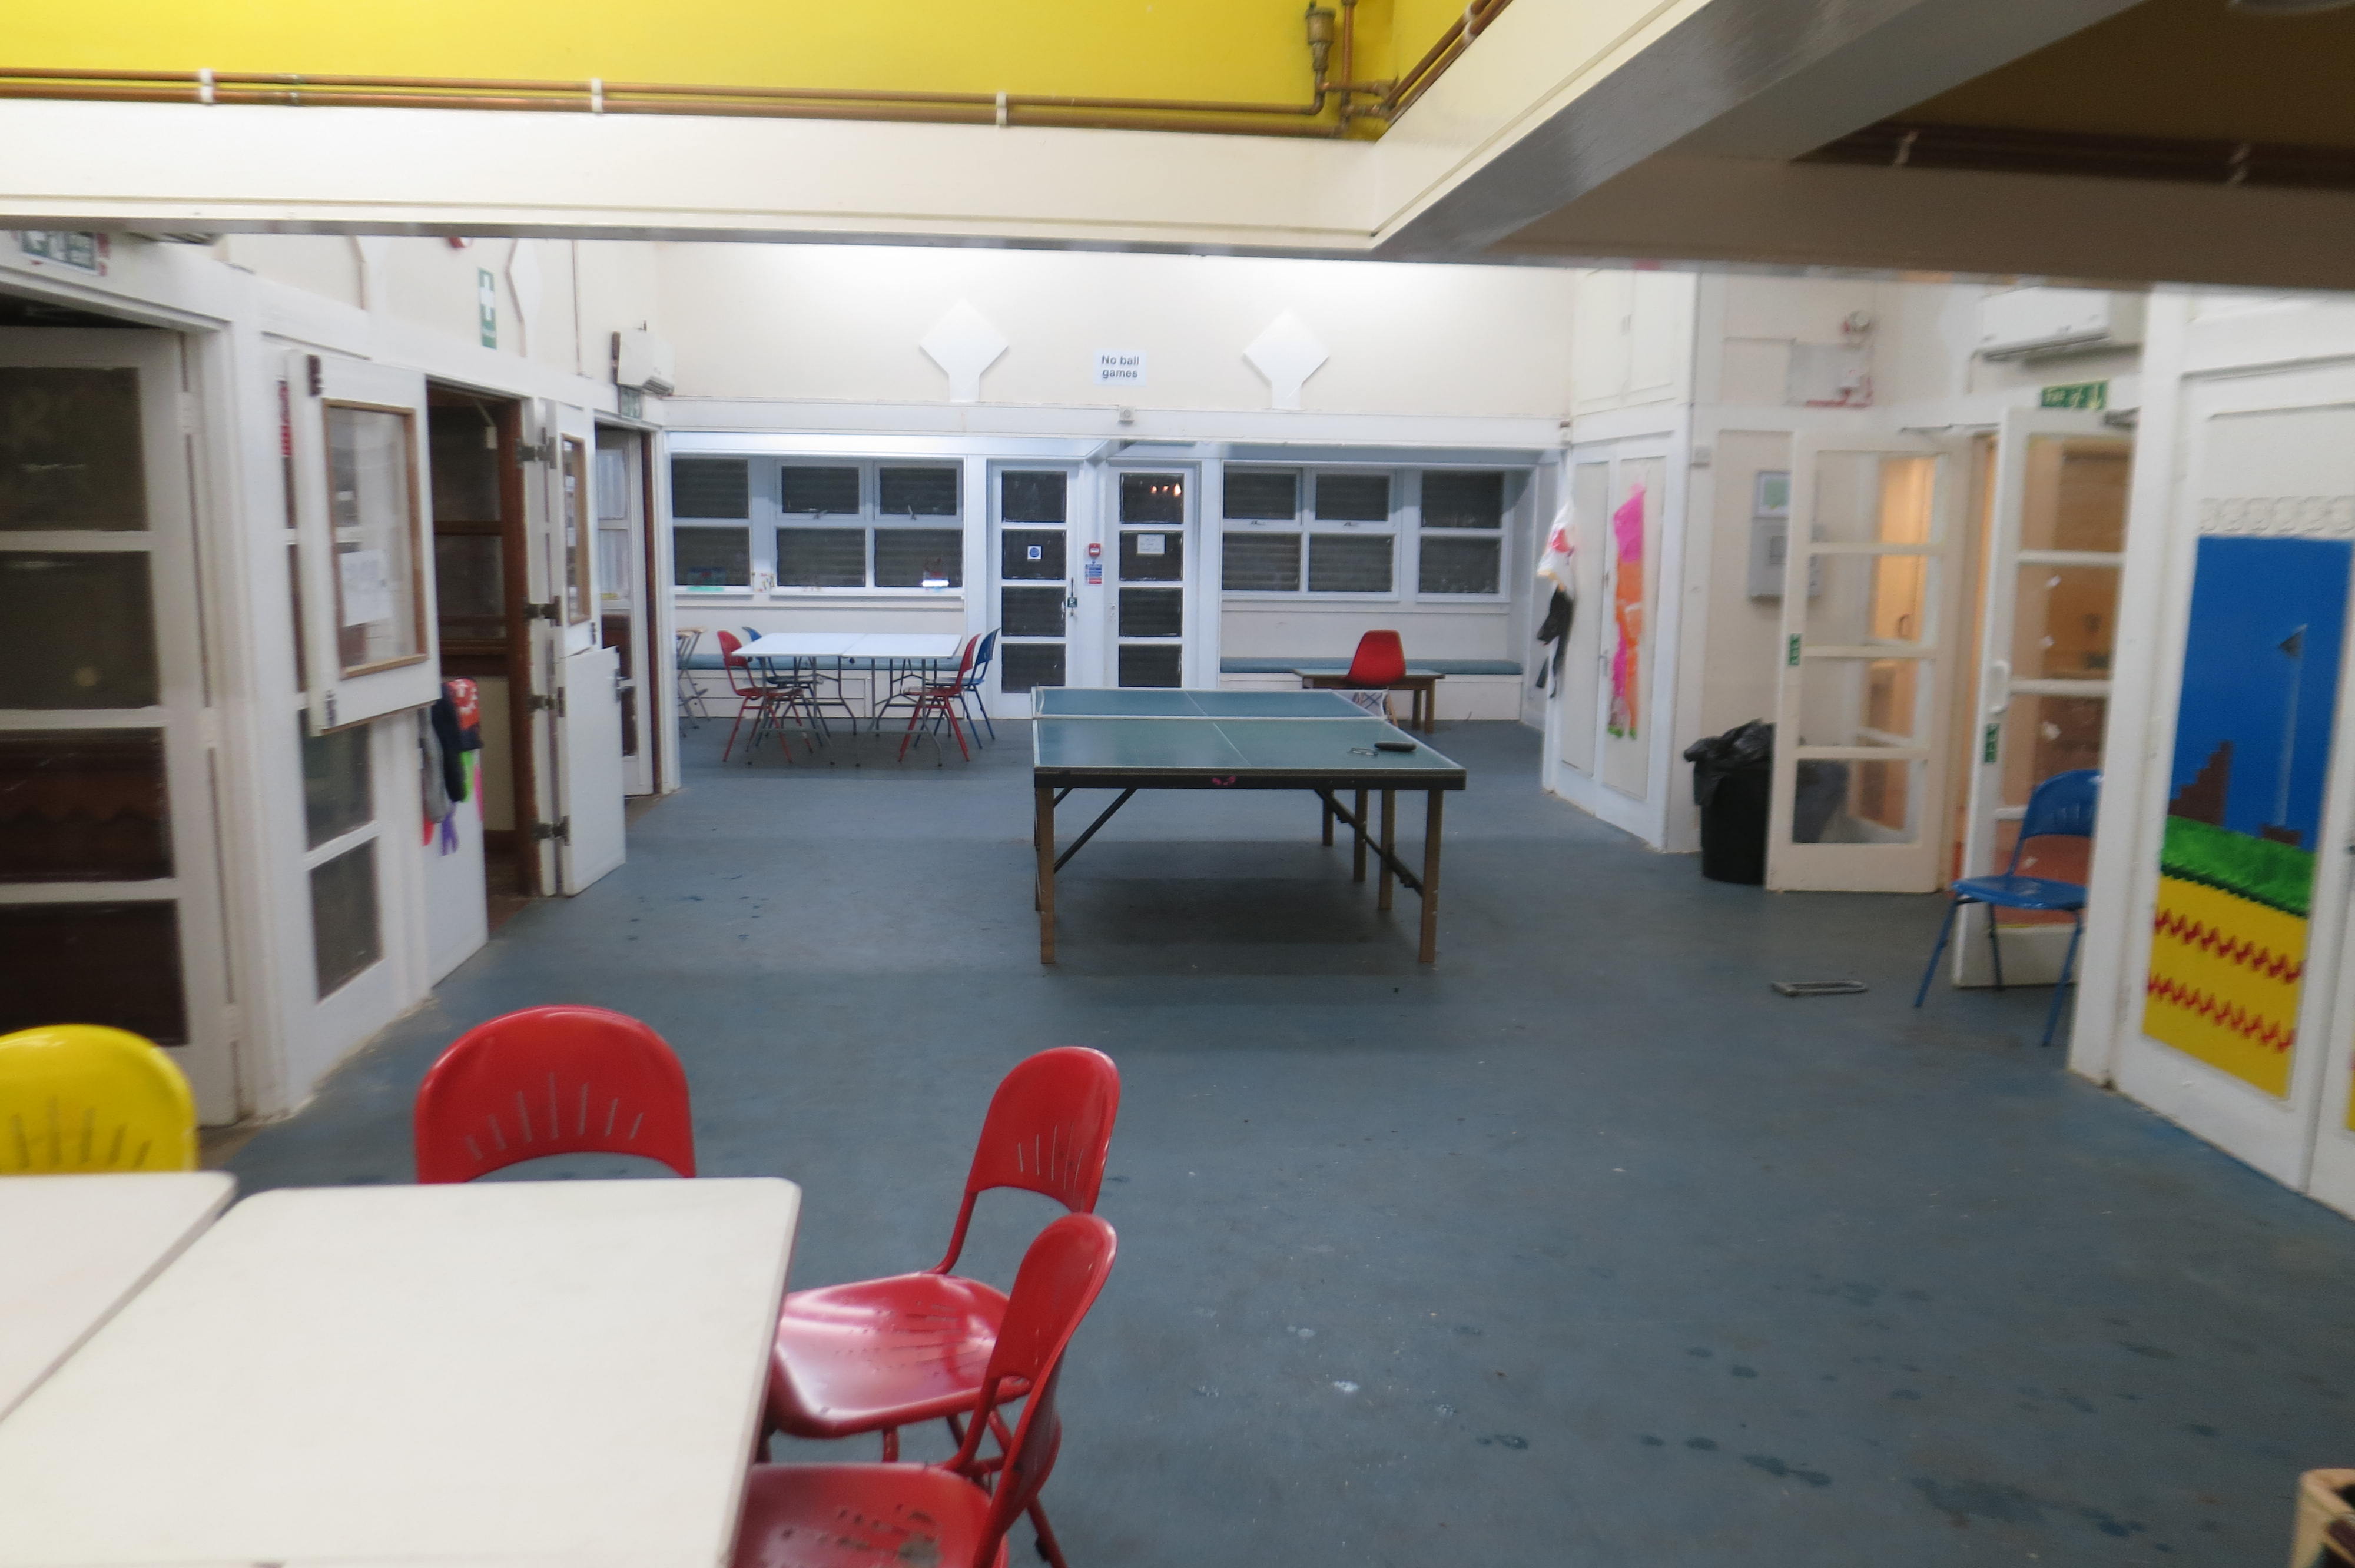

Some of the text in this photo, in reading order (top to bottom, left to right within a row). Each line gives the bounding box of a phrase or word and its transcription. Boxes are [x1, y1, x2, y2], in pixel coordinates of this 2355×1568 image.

[1102, 354, 1139, 365] No ball
[1102, 369, 1137, 379] games
